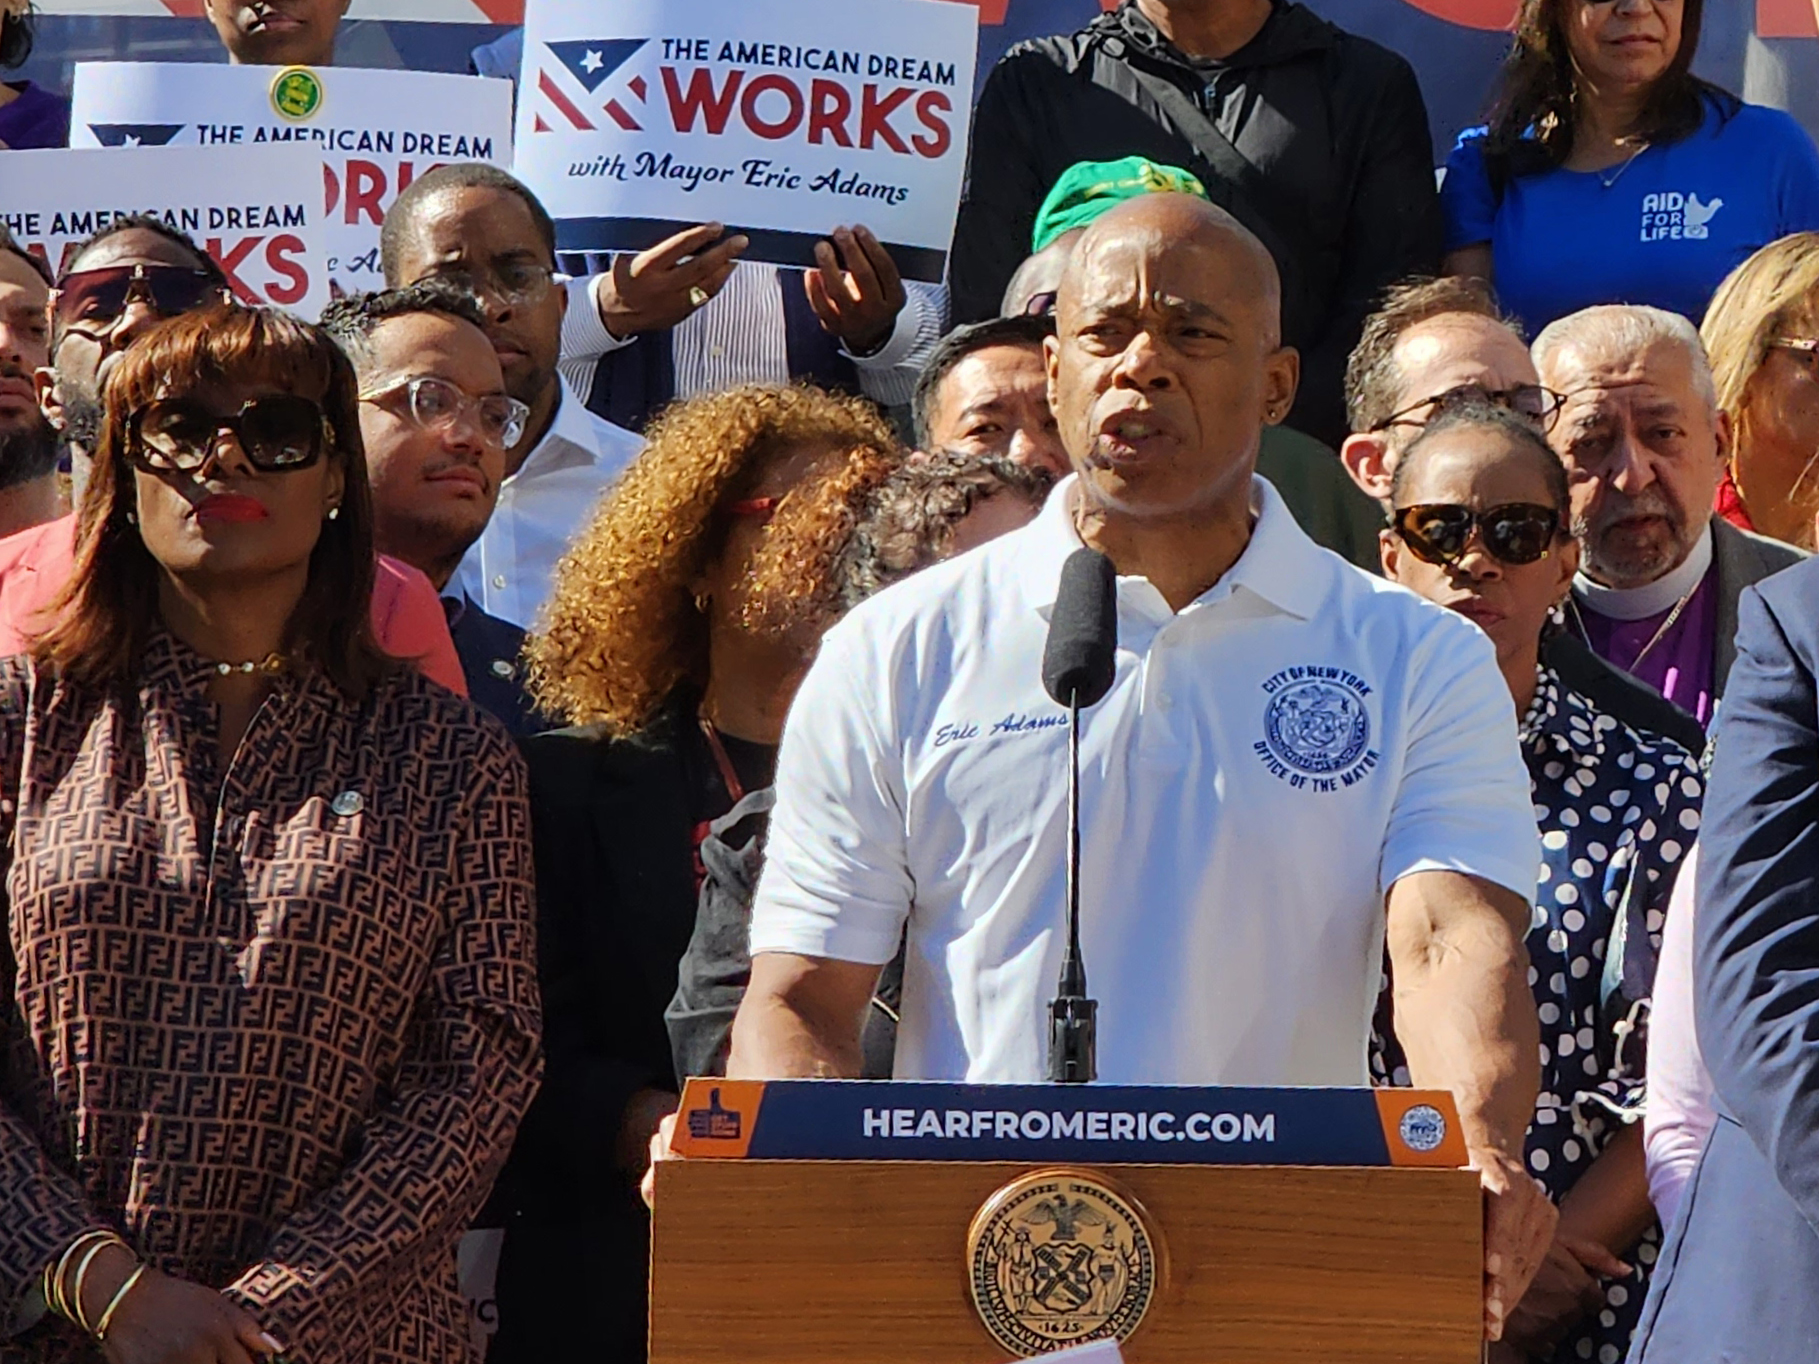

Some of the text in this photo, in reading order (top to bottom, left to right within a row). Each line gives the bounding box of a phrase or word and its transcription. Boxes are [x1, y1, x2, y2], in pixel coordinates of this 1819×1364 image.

[662, 38, 956, 86] THE AMERICAN DREAM
[660, 66, 953, 160] WORKS
[197, 124, 243, 145] THE
[401, 133, 493, 160] DREAM
[568, 151, 910, 206] with Mayor Eric Adams
[208, 204, 306, 231] DREAM
[1642, 192, 1684, 213] AID
[1642, 212, 1682, 227] FOR
[1640, 225, 1682, 242] LIFE
[1262, 665, 1373, 698] CITY OF NEW YORK
[934, 713, 1069, 747] Eric Adams
[1254, 740, 1381, 793] OFFICE OF THE MAYOR
[861, 1106, 1277, 1144] HEARFROMERIC.COM
